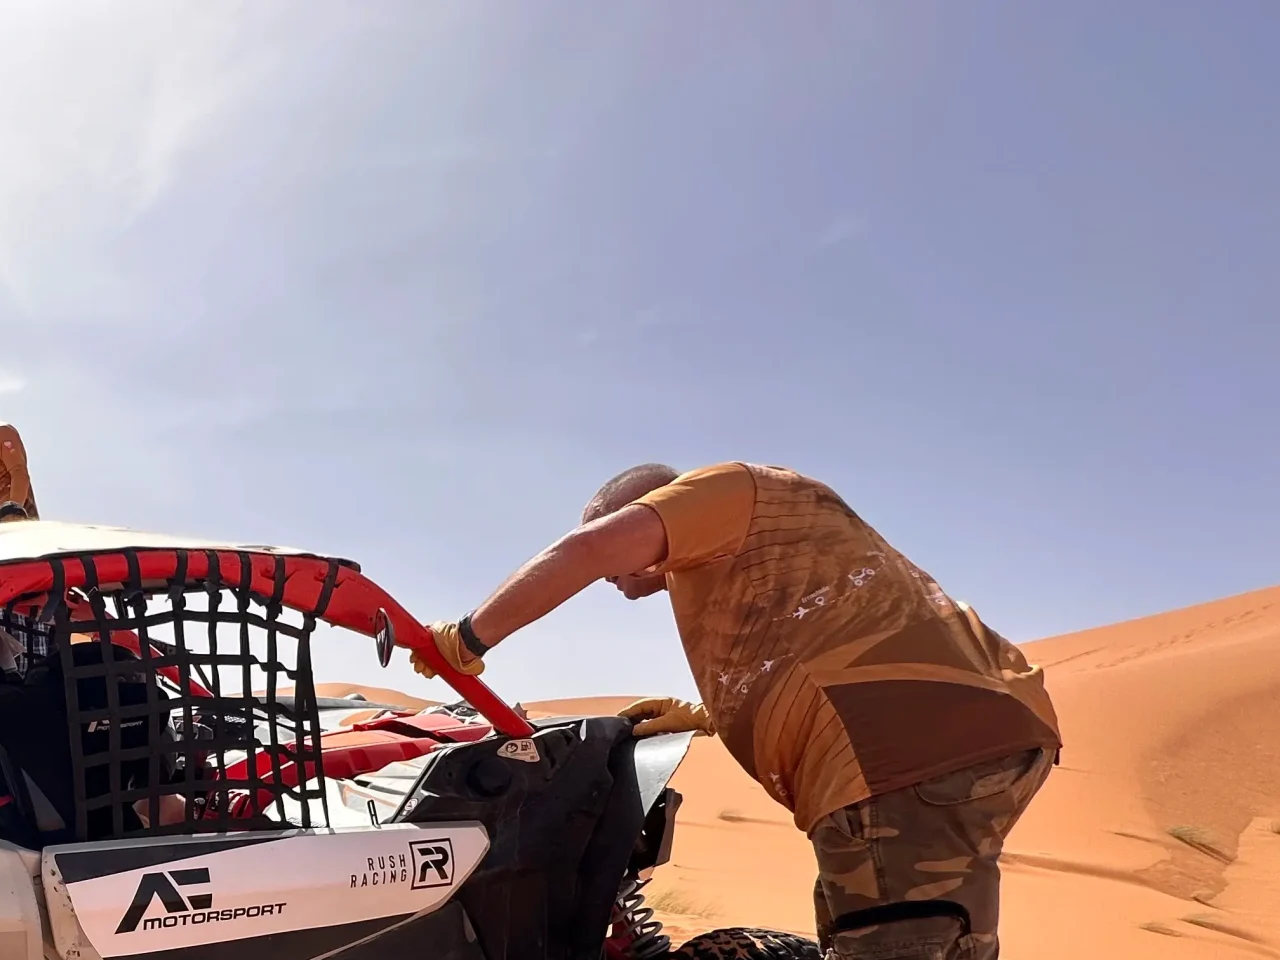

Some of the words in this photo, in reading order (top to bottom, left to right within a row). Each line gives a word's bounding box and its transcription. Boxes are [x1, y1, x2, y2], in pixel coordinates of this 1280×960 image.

[367, 854, 406, 871] RUSH
[350, 868, 407, 888] RACING
[143, 903, 287, 930] MOTORSPORT
